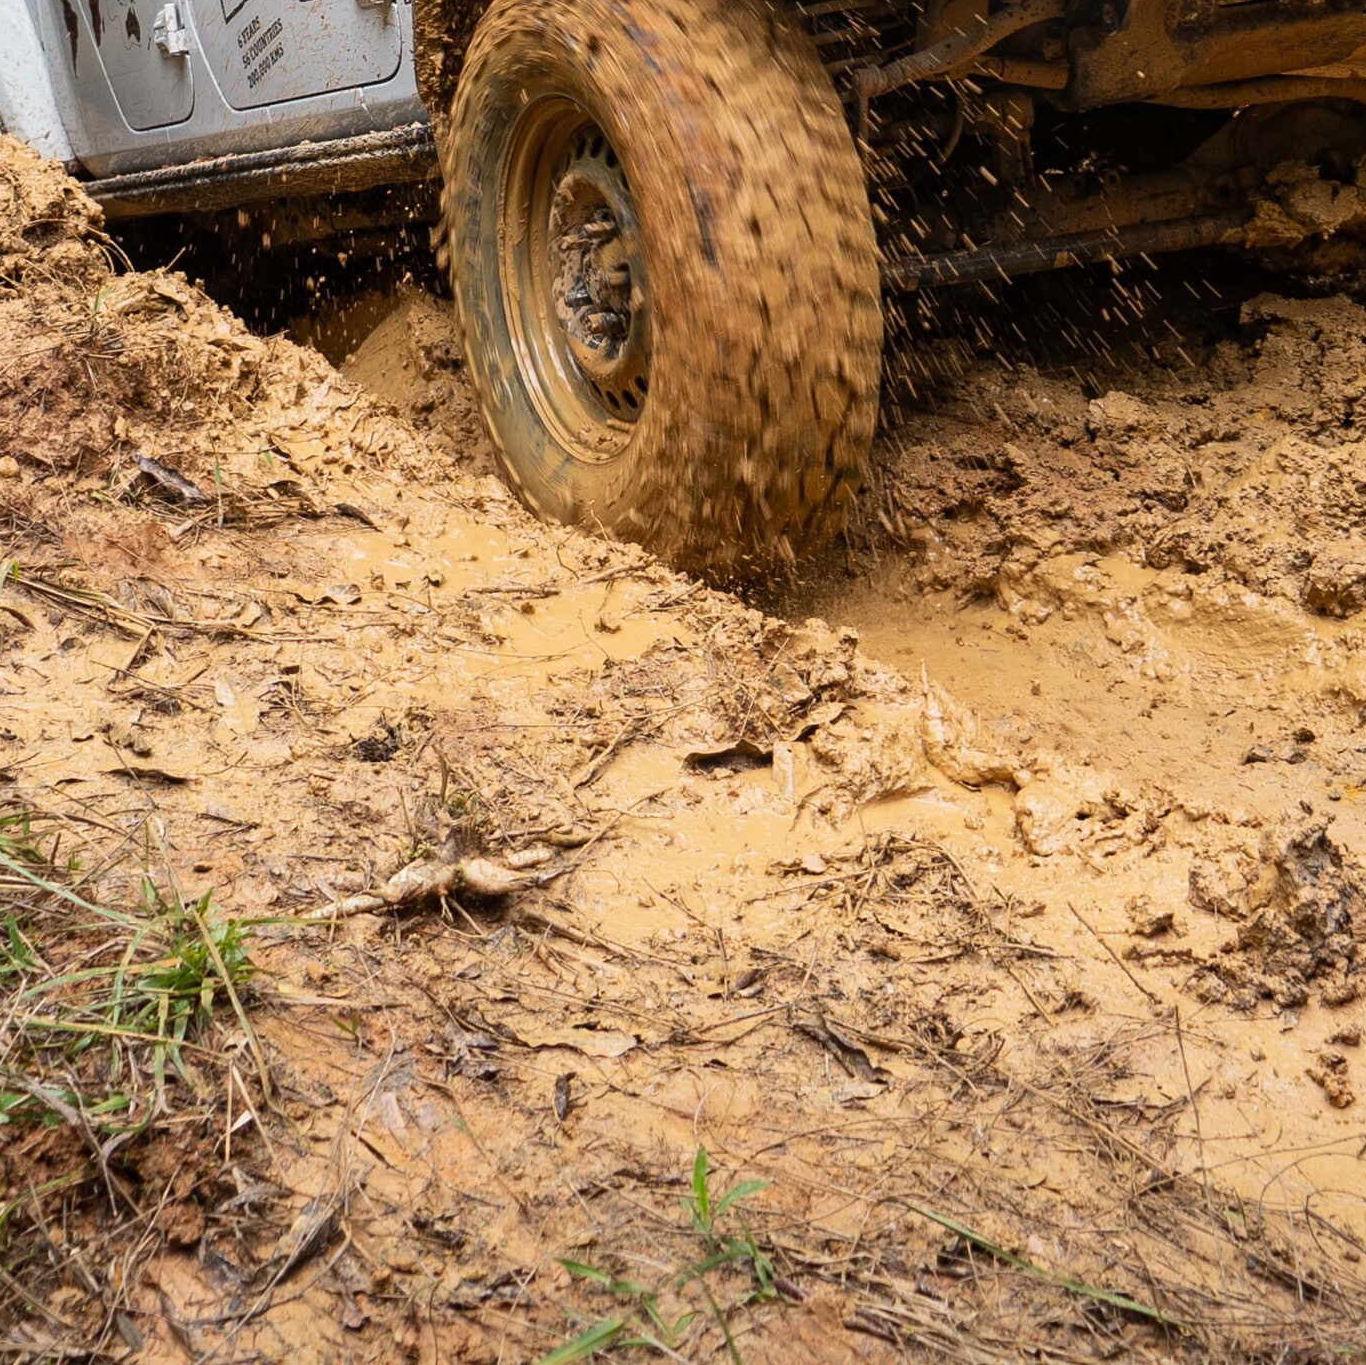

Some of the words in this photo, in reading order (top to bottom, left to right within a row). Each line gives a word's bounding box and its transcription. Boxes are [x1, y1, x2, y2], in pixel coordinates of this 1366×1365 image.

[237, 34, 244, 48] 6
[242, 15, 261, 44] YEARS
[250, 17, 283, 61] COUNTRIES
[270, 42, 284, 66] KMS
